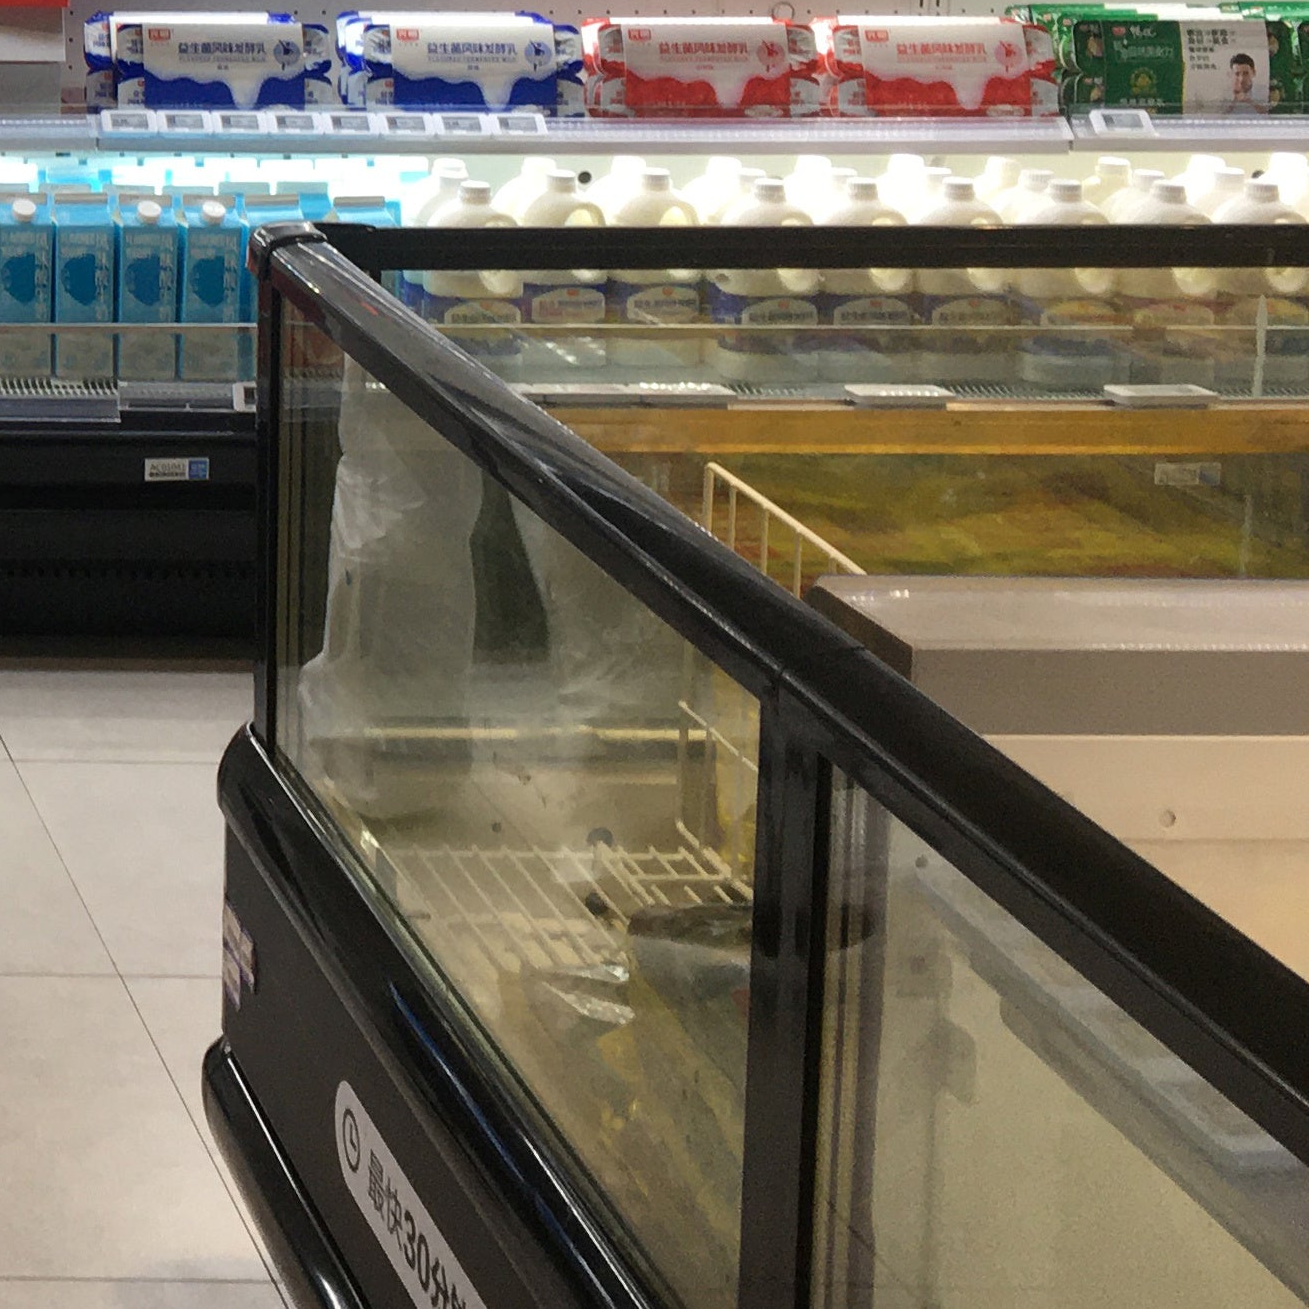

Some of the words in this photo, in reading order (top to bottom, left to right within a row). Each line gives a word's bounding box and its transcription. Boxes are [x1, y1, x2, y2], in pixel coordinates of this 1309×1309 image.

[179, 43, 266, 54] 益生菌风味发酵乳
[428, 43, 515, 54] 益生菌风味发酵乳
